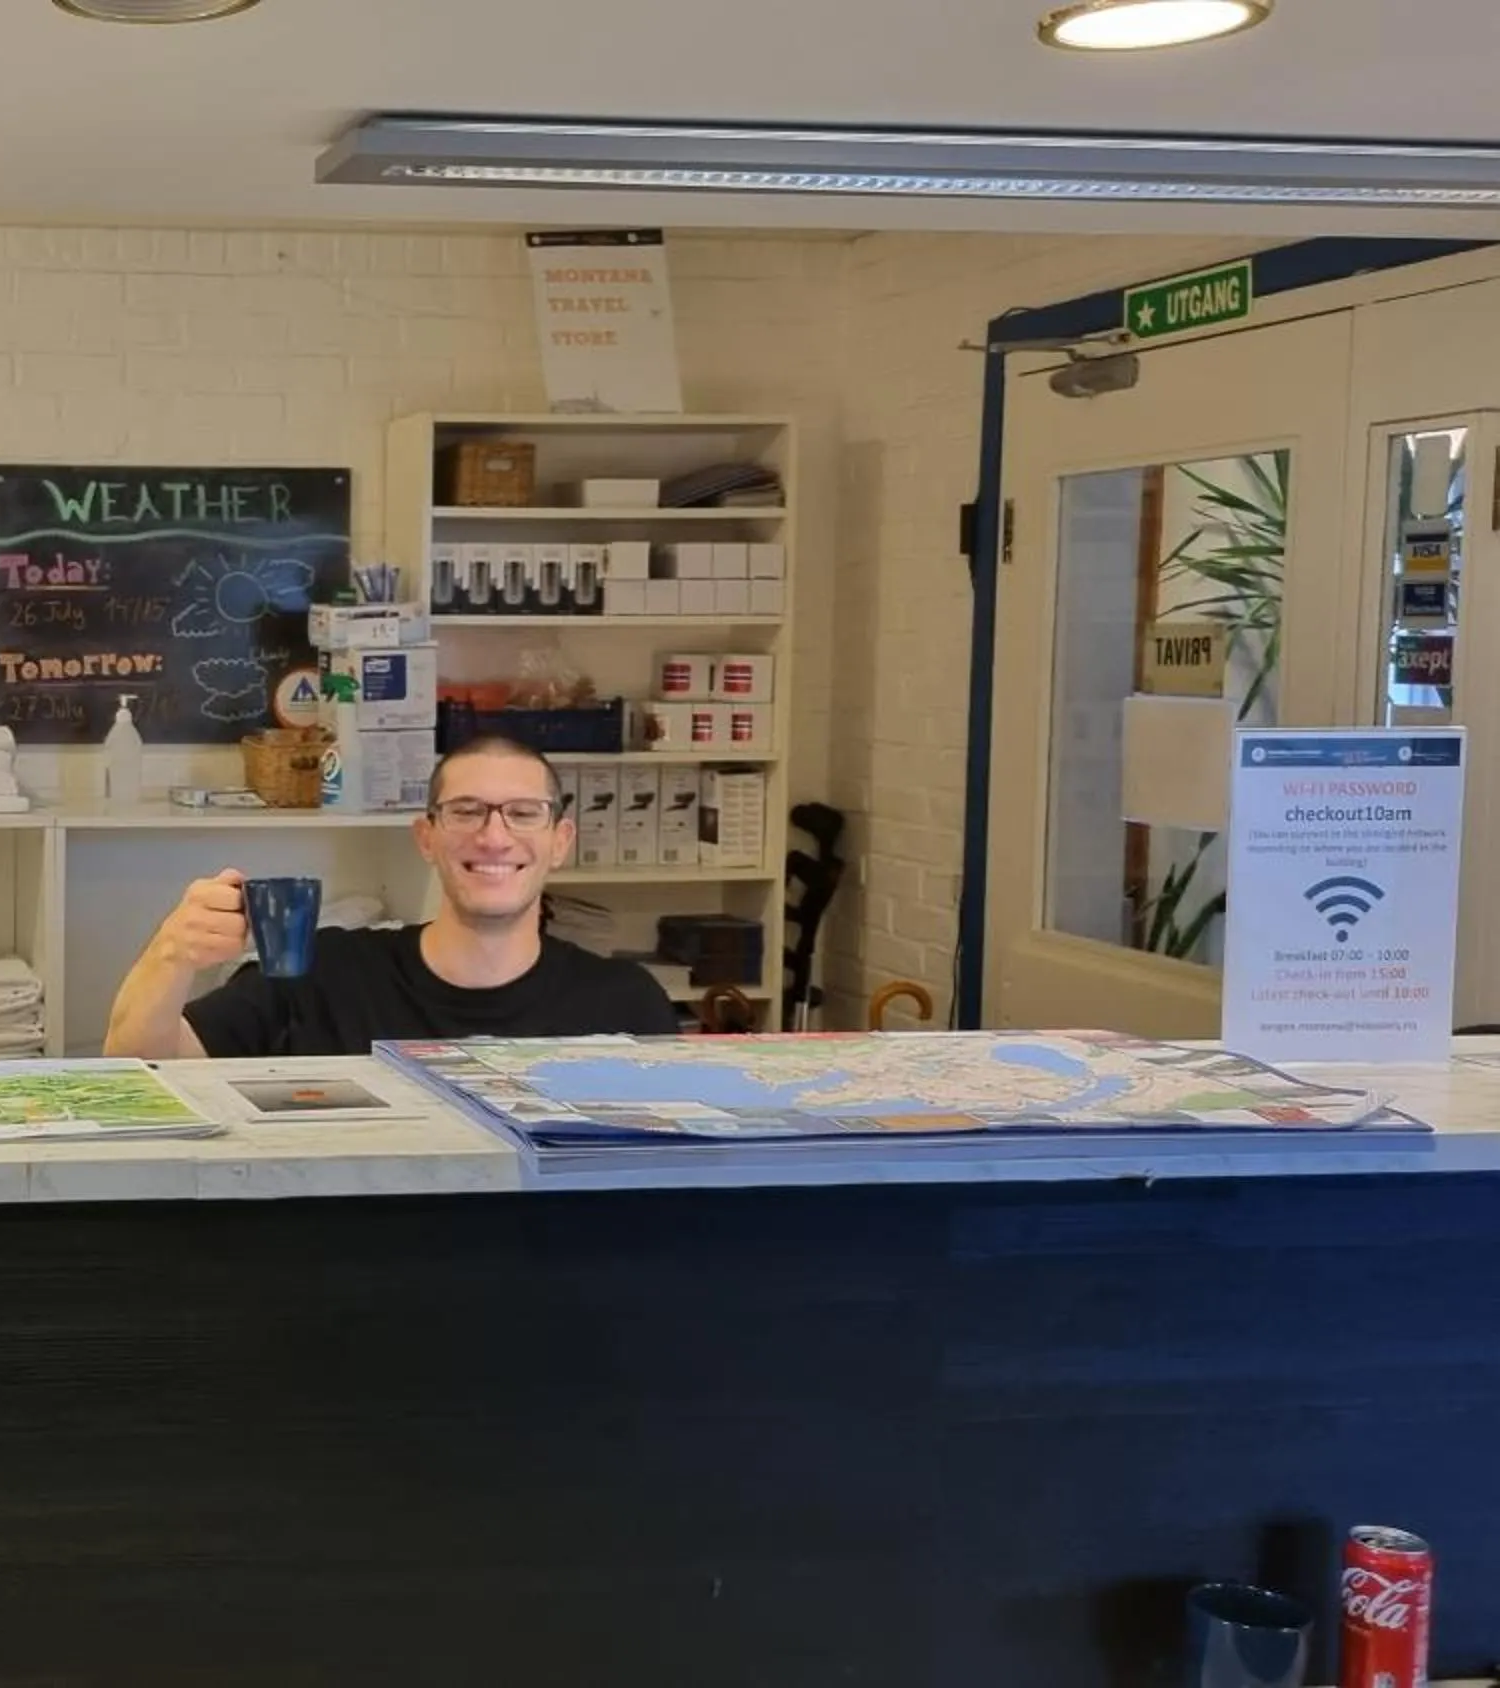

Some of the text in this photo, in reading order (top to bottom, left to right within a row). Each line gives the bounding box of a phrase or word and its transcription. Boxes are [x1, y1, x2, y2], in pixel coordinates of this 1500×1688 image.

[544, 268, 653, 284] MONTANA
[547, 297, 631, 313] TRAVEL
[1166, 275, 1241, 325] UTGANG
[551, 330, 618, 346] STORE
[41, 479, 294, 525] WEATHER
[10, 603, 37, 627] 26
[45, 602, 86, 631] July
[1283, 781, 1417, 797] WI-FI PASSWORD
[1285, 805, 1413, 822] checkout10am
